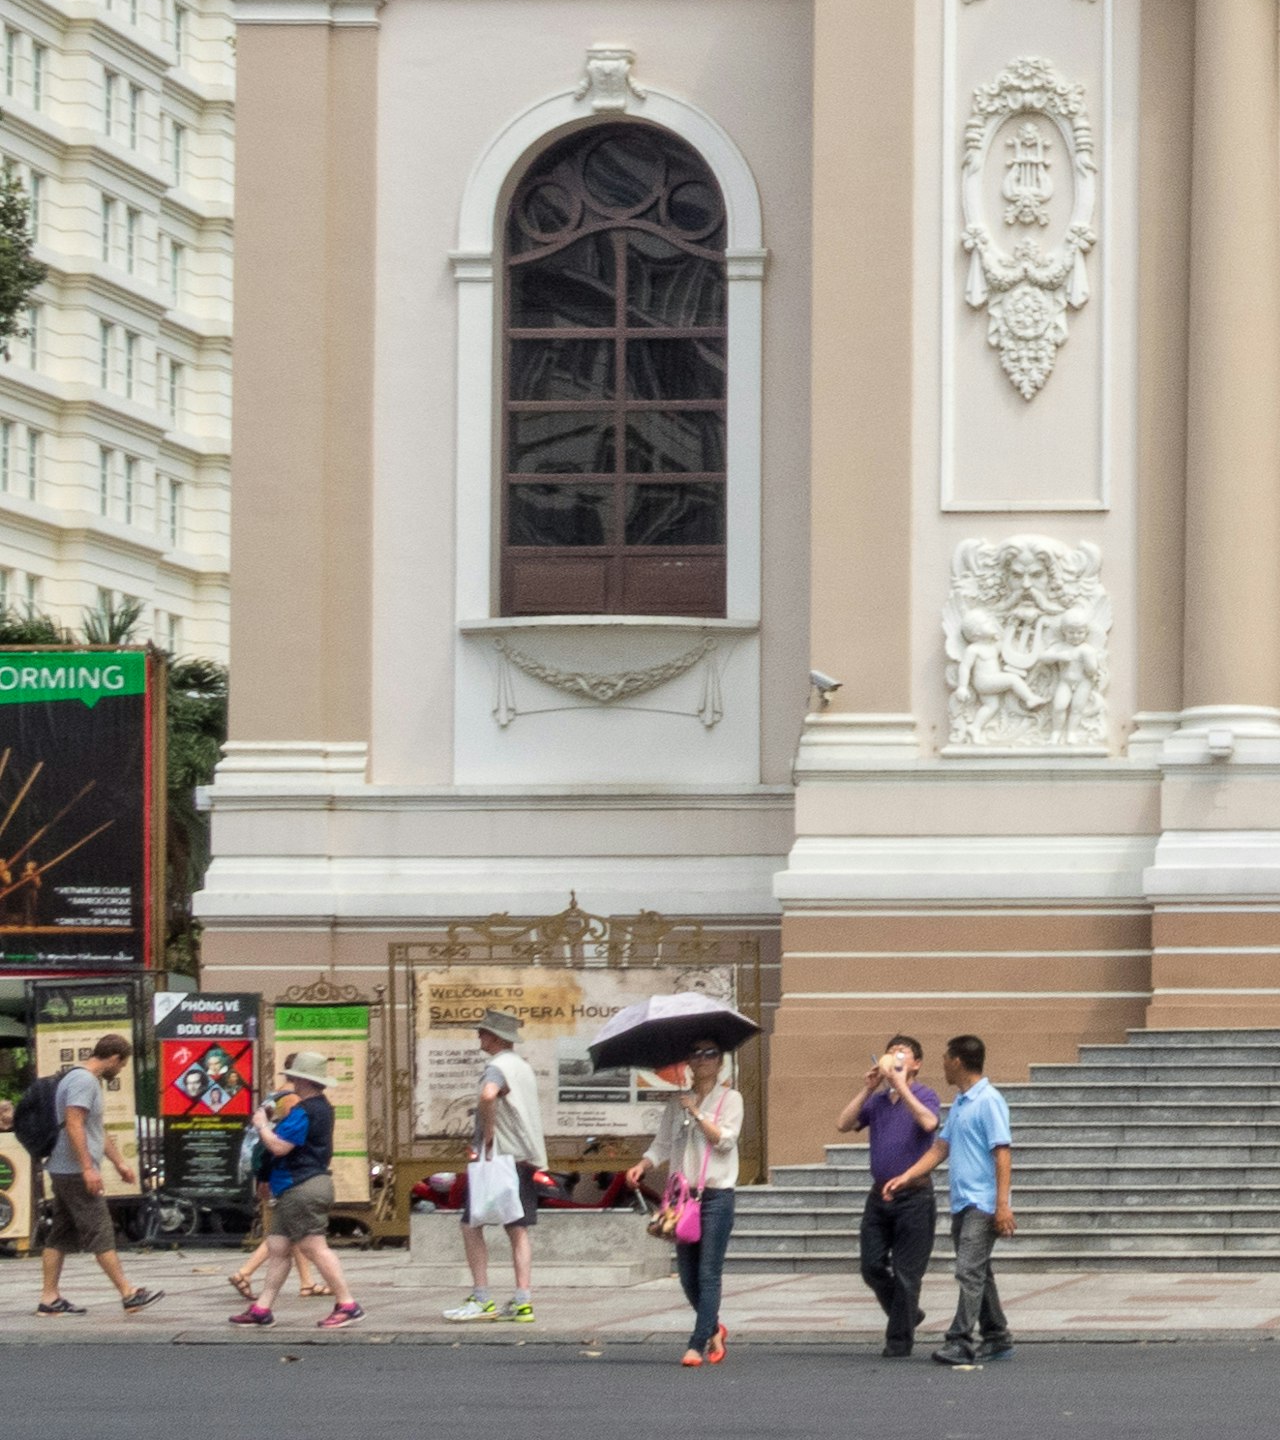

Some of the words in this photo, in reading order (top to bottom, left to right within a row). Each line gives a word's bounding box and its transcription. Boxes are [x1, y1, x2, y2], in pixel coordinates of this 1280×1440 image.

[430, 987, 503, 999] WELCOME
[507, 987, 524, 998] TO
[430, 1005, 497, 1019] SAIGO
[571, 1004, 627, 1018] HOUS
[177, 1024, 202, 1035] BOX
[203, 1024, 243, 1035] OFFICE
